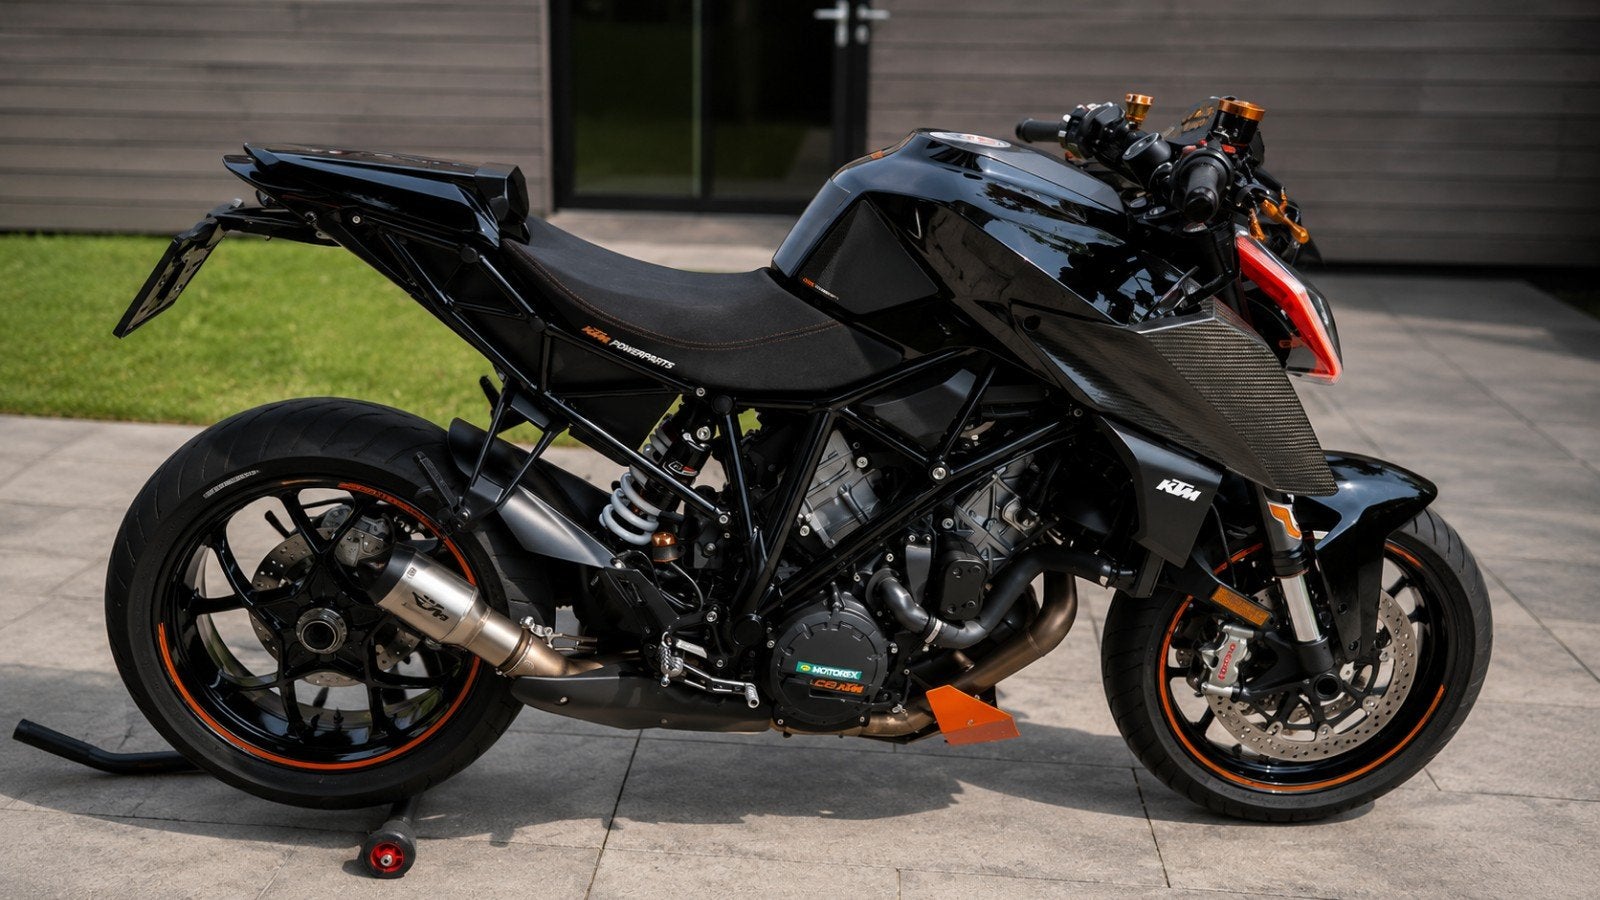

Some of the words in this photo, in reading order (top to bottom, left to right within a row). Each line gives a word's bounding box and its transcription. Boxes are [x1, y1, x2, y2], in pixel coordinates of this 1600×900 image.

[609, 340, 676, 369] POWERPARTS
[1155, 478, 1202, 502] KTM
[812, 666, 858, 679] MOTOREX
